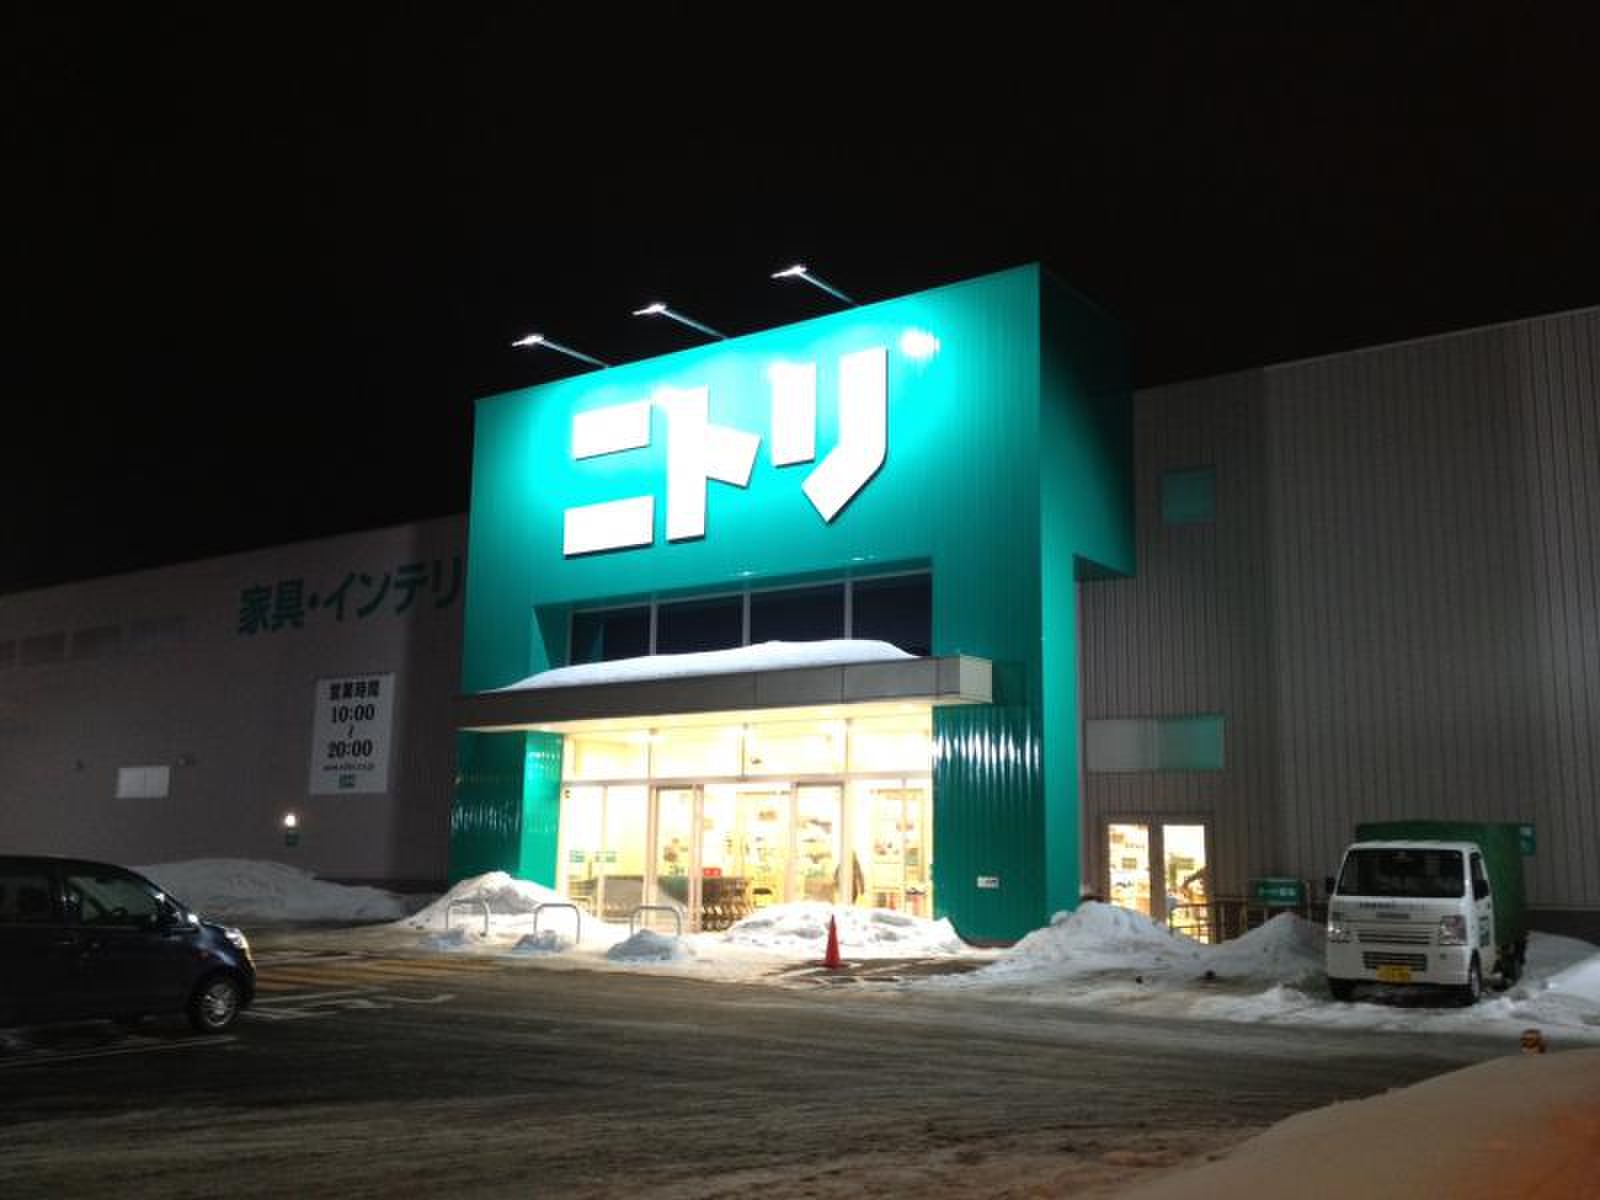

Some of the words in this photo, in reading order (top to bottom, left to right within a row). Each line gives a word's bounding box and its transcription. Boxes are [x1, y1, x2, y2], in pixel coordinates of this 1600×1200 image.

[563, 346, 888, 560] ニトリ
[331, 703, 376, 723] 10:00
[327, 739, 373, 759] 20:00
